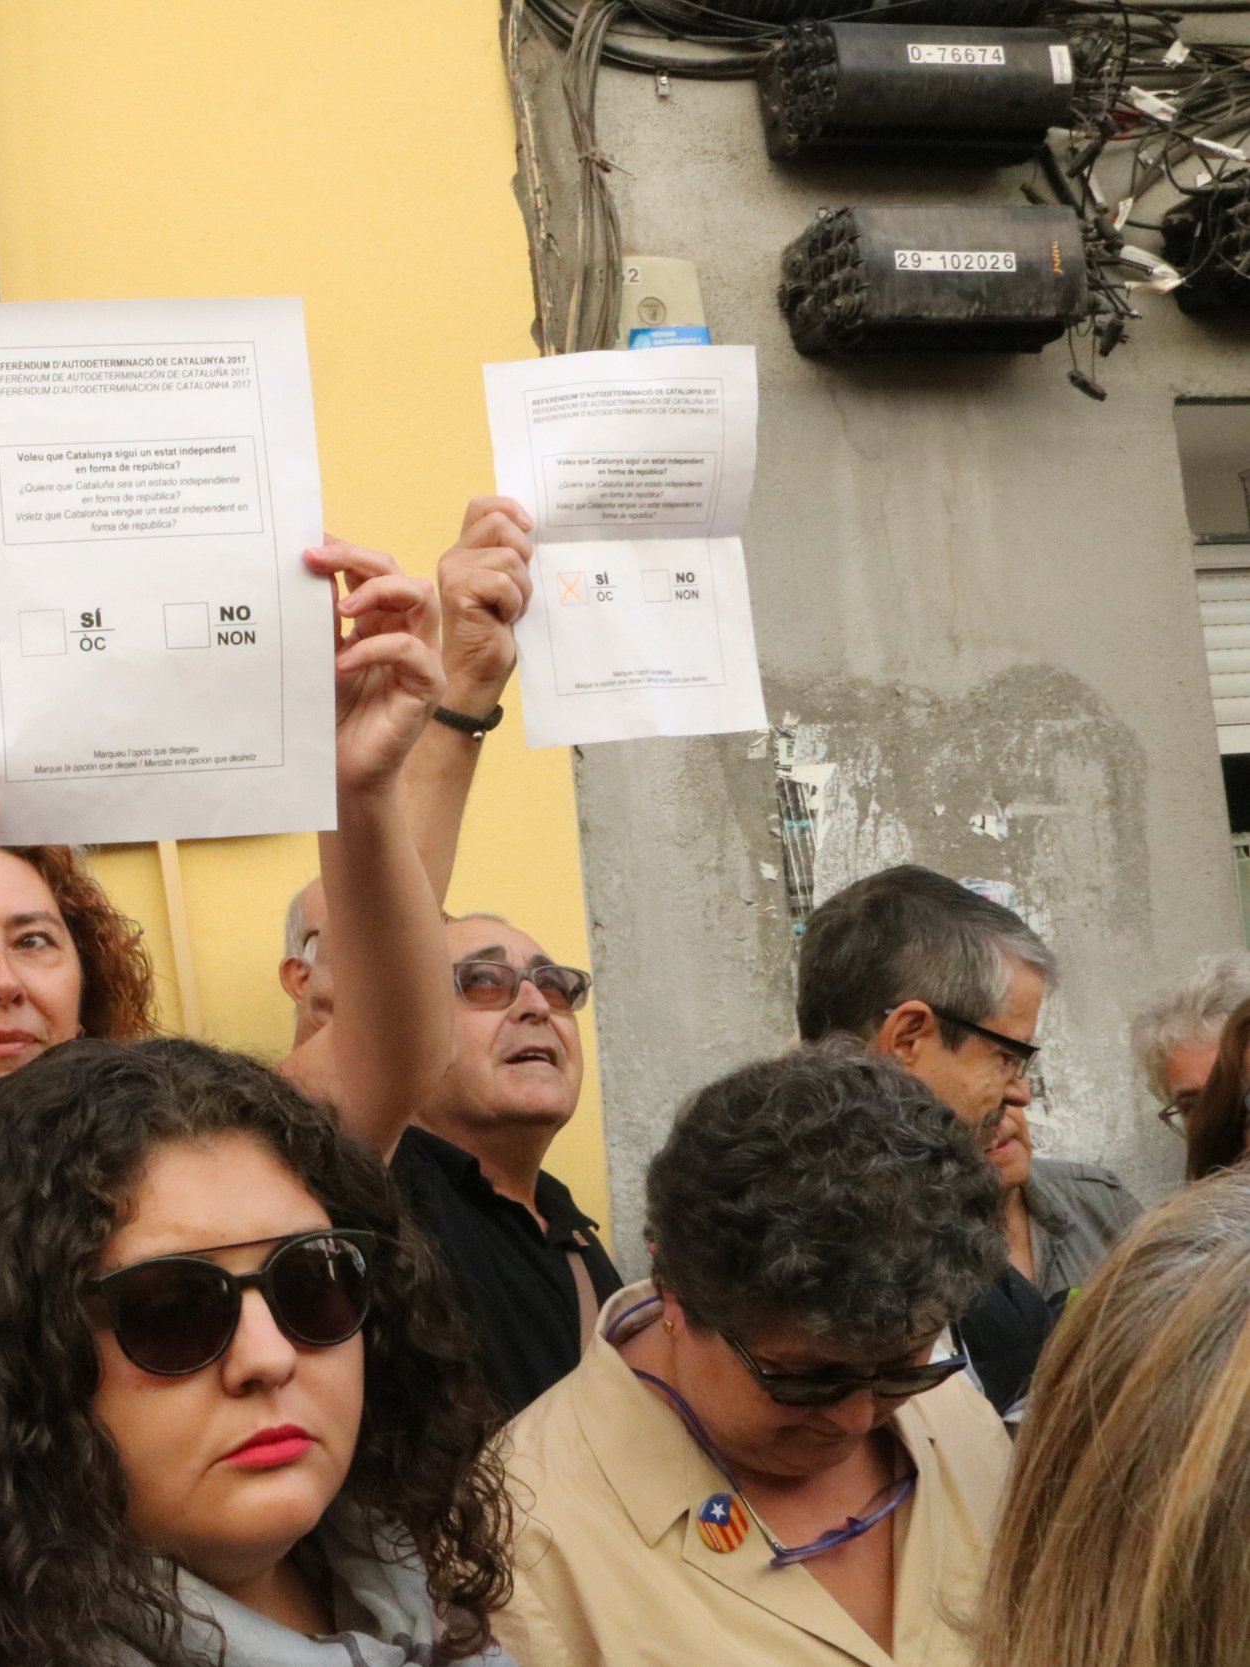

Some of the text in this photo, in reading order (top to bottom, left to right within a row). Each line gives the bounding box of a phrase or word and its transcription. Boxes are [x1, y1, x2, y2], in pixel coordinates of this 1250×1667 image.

[910, 46, 1002, 63] 0-76674
[897, 252, 1015, 270] 29-102026
[156, 357, 168, 366] DE
[170, 355, 224, 367] CATALUNYA
[226, 355, 246, 364] 2017
[51, 372, 64, 382] DE
[166, 369, 179, 379] DE
[230, 367, 249, 376] 2017
[52, 382, 159, 395] D'AUTODETERMINACION
[161, 381, 173, 391] DE
[175, 380, 229, 391] CATALONHA
[232, 379, 251, 389] 2017
[16, 444, 236, 462] Voleu que Catalunya sigui un estat independent
[74, 466, 86, 474] en
[88, 463, 116, 473] forma
[118, 462, 130, 471] de
[56, 482, 72, 493] que
[116, 480, 132, 488] sea
[134, 479, 146, 487] un
[147, 476, 177, 487] estado
[179, 474, 240, 487] independiente
[81, 496, 93, 504] en
[94, 493, 120, 503] forma
[122, 492, 134, 502] de
[15, 503, 248, 522] Voletz que Catalonha vengue un estat independent en
[90, 518, 176, 532] forma de republica?
[595, 571, 610, 586] SÍ
[675, 572, 696, 584] NO
[674, 589, 700, 601] NON
[80, 608, 102, 628] SÍ
[219, 605, 252, 622] NO
[79, 634, 107, 652] ÒC
[217, 630, 256, 646] NON
